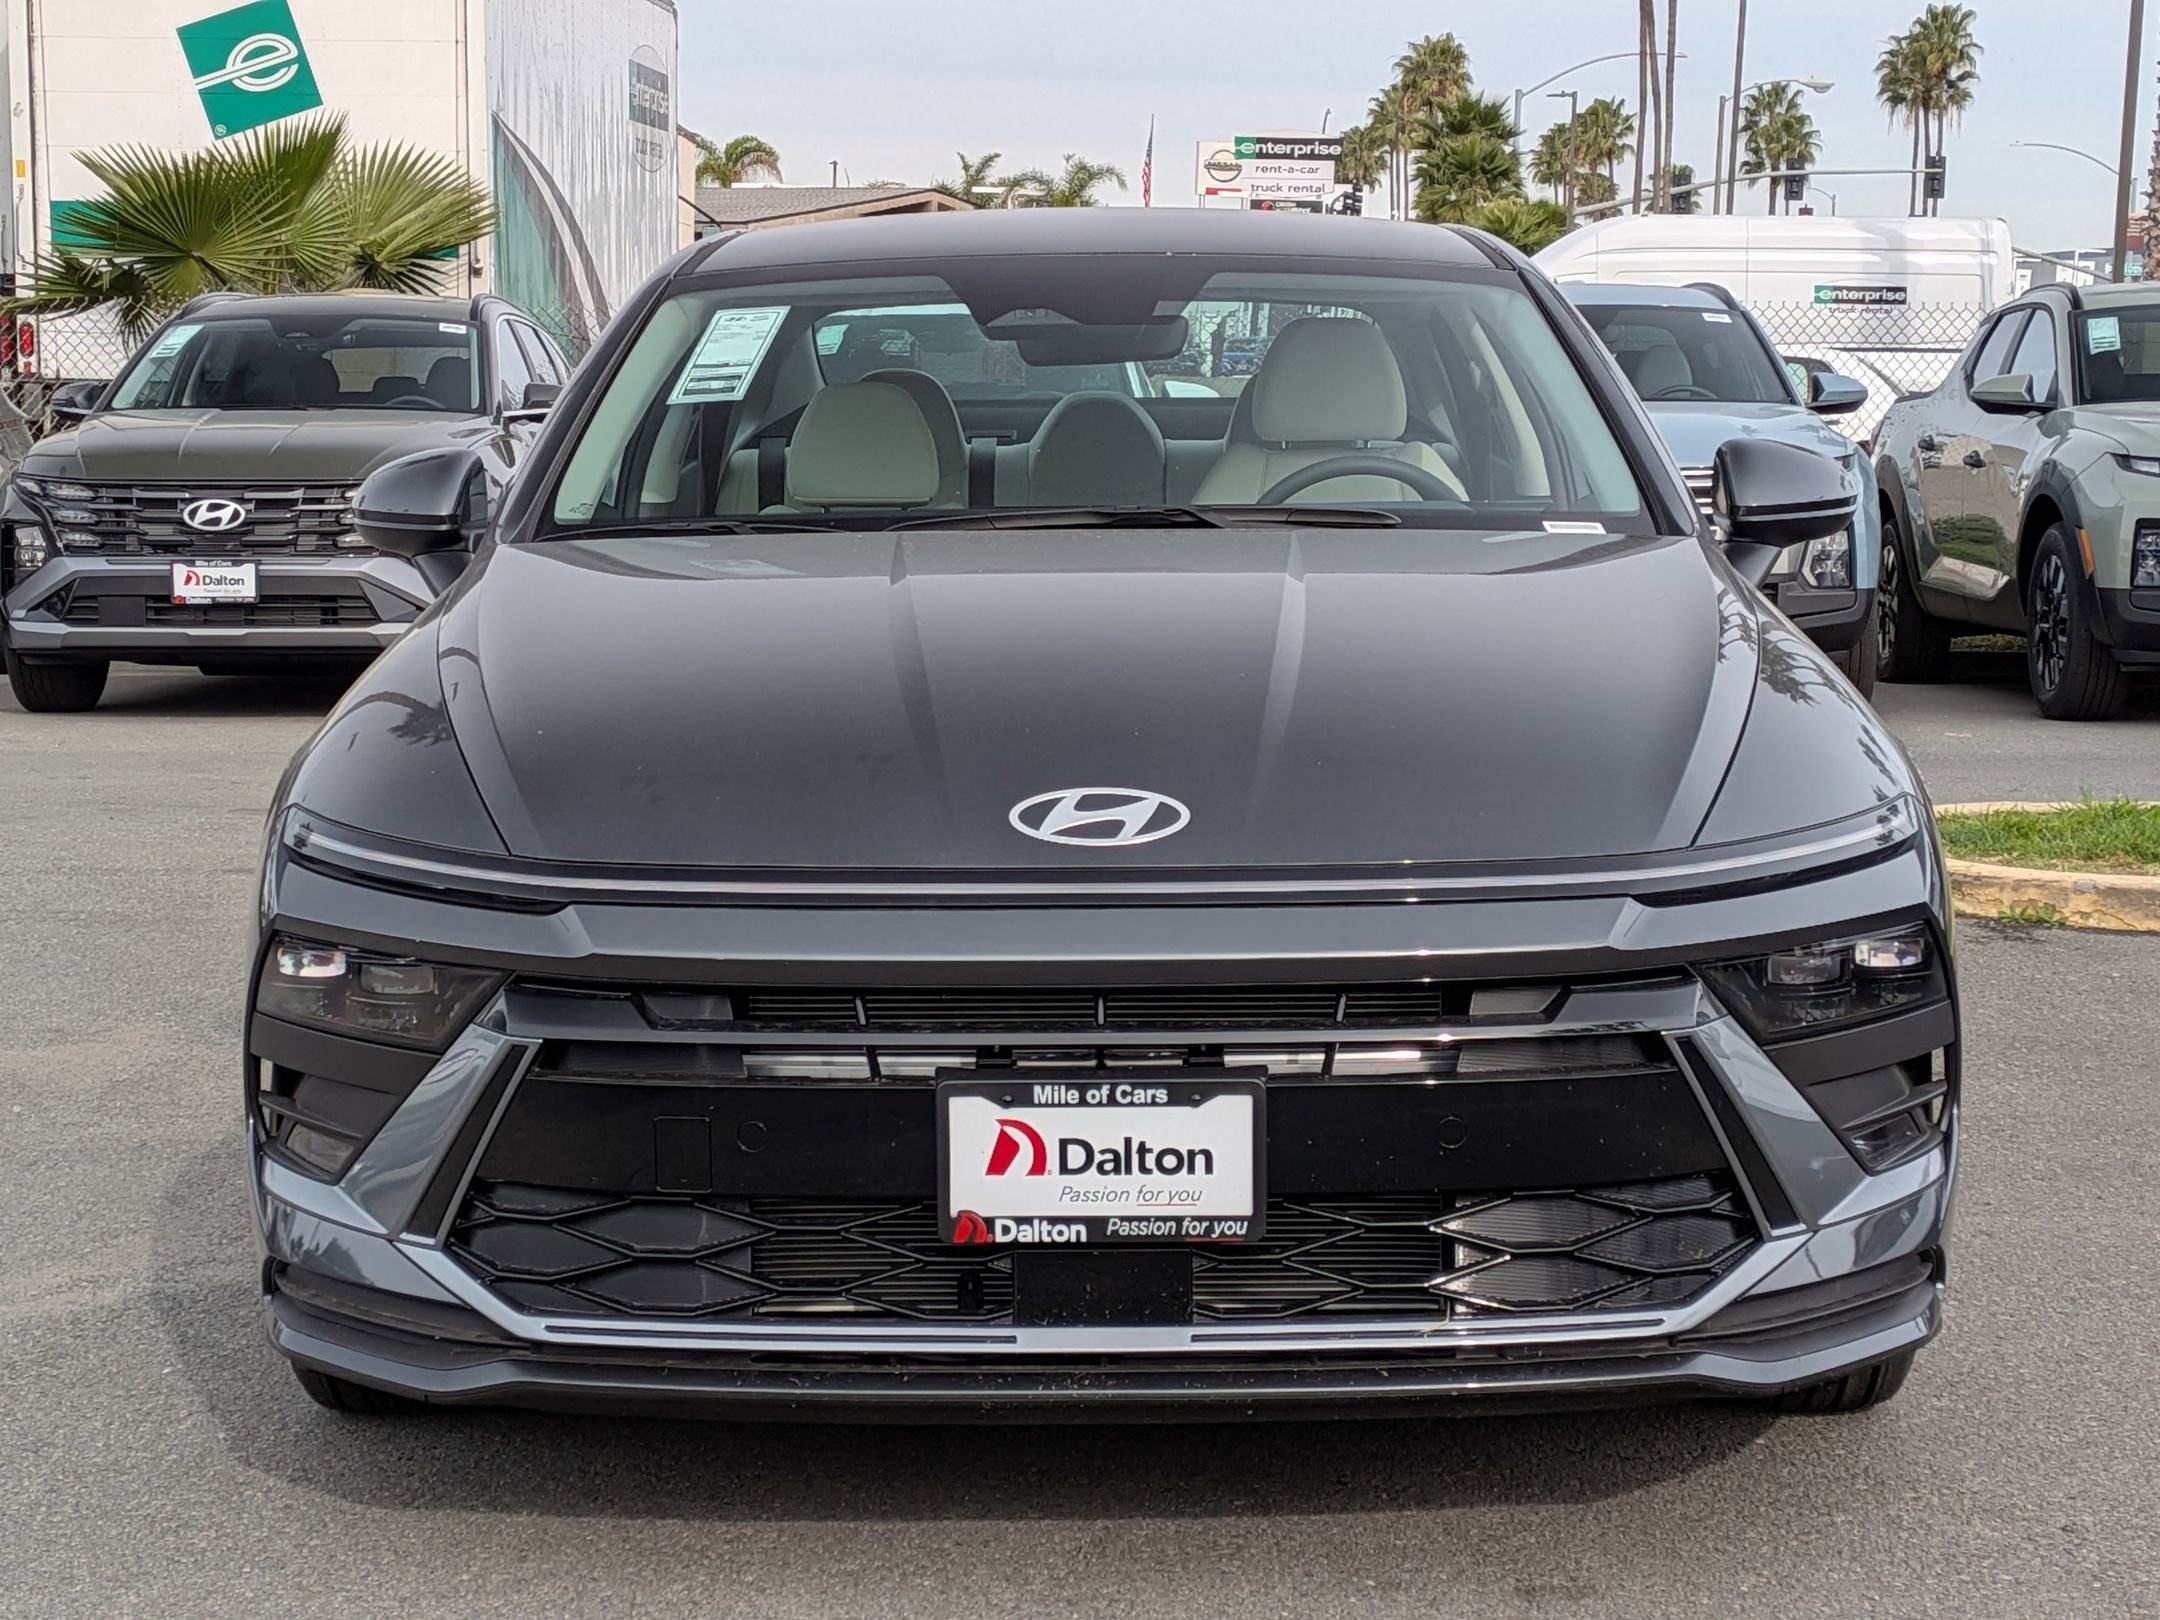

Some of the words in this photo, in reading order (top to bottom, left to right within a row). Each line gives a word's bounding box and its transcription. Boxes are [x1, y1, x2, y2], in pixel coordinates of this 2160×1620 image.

[1239, 141, 1343, 158] enterprise
[1255, 165, 1320, 174] rent-a-car
[1251, 183, 1283, 193] truck
[1288, 183, 1325, 193] rental
[1820, 289, 1905, 302] enterprise
[202, 574, 245, 586] Dalton
[1032, 1084, 1082, 1105] Mile
[1085, 1084, 1111, 1105] of
[1115, 1084, 1169, 1105] Cars
[1057, 1136, 1215, 1177] Dalton
[1058, 1186, 1131, 1203] Passion
[1135, 1184, 1162, 1204] for
[1166, 1188, 1202, 1206] you
[994, 1218, 1088, 1243] Dalton
[1106, 1217, 1178, 1237] Passion
[1181, 1217, 1208, 1239] for
[1210, 1218, 1249, 1239] you
